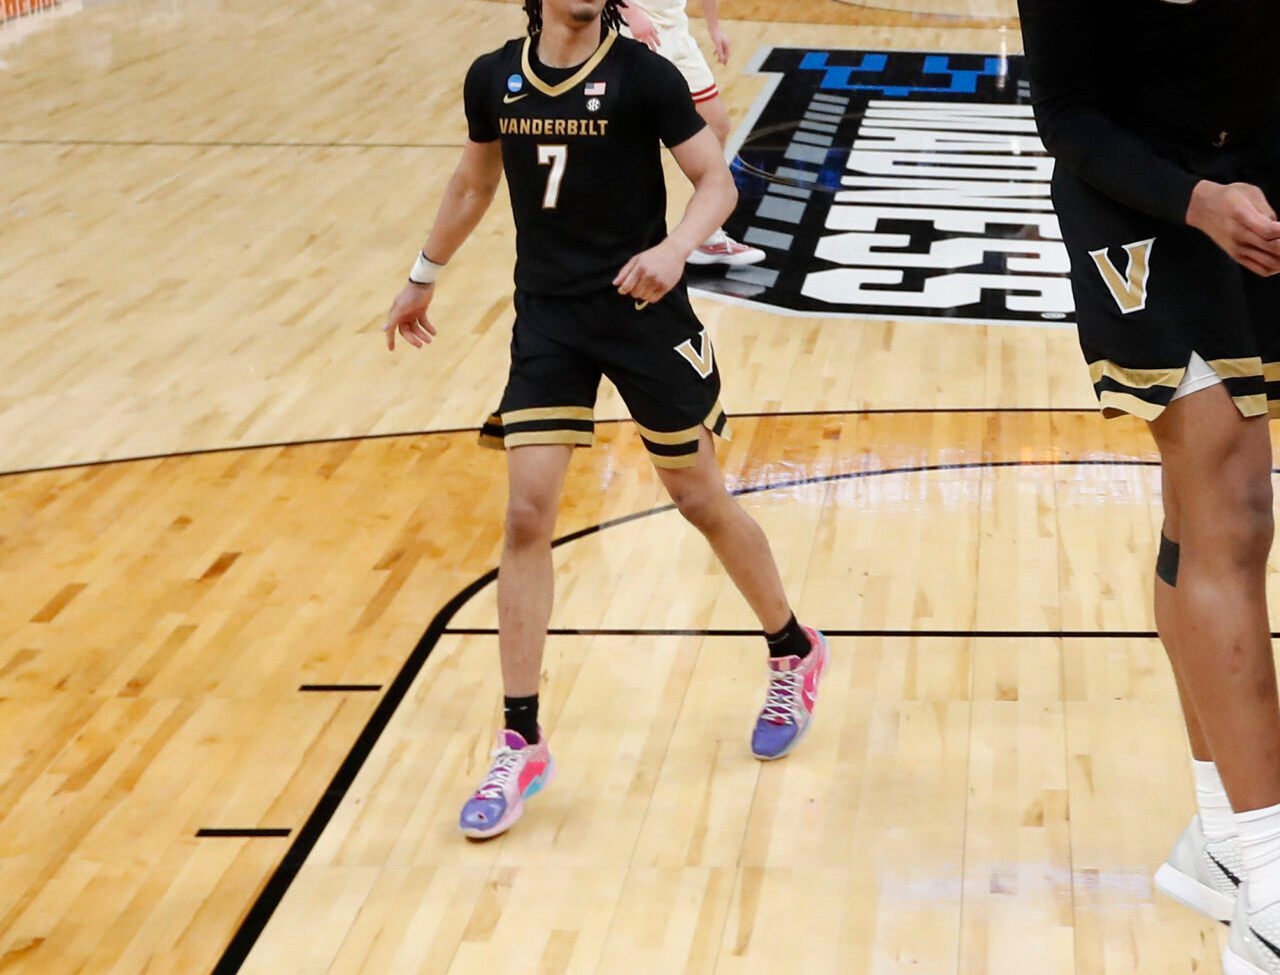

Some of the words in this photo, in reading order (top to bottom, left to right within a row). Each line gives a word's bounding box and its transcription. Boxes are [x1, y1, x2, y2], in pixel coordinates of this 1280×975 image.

[499, 117, 608, 136] VANDERBILT
[537, 144, 568, 210] 7
[1087, 236, 1157, 315] V
[673, 328, 713, 379] V
